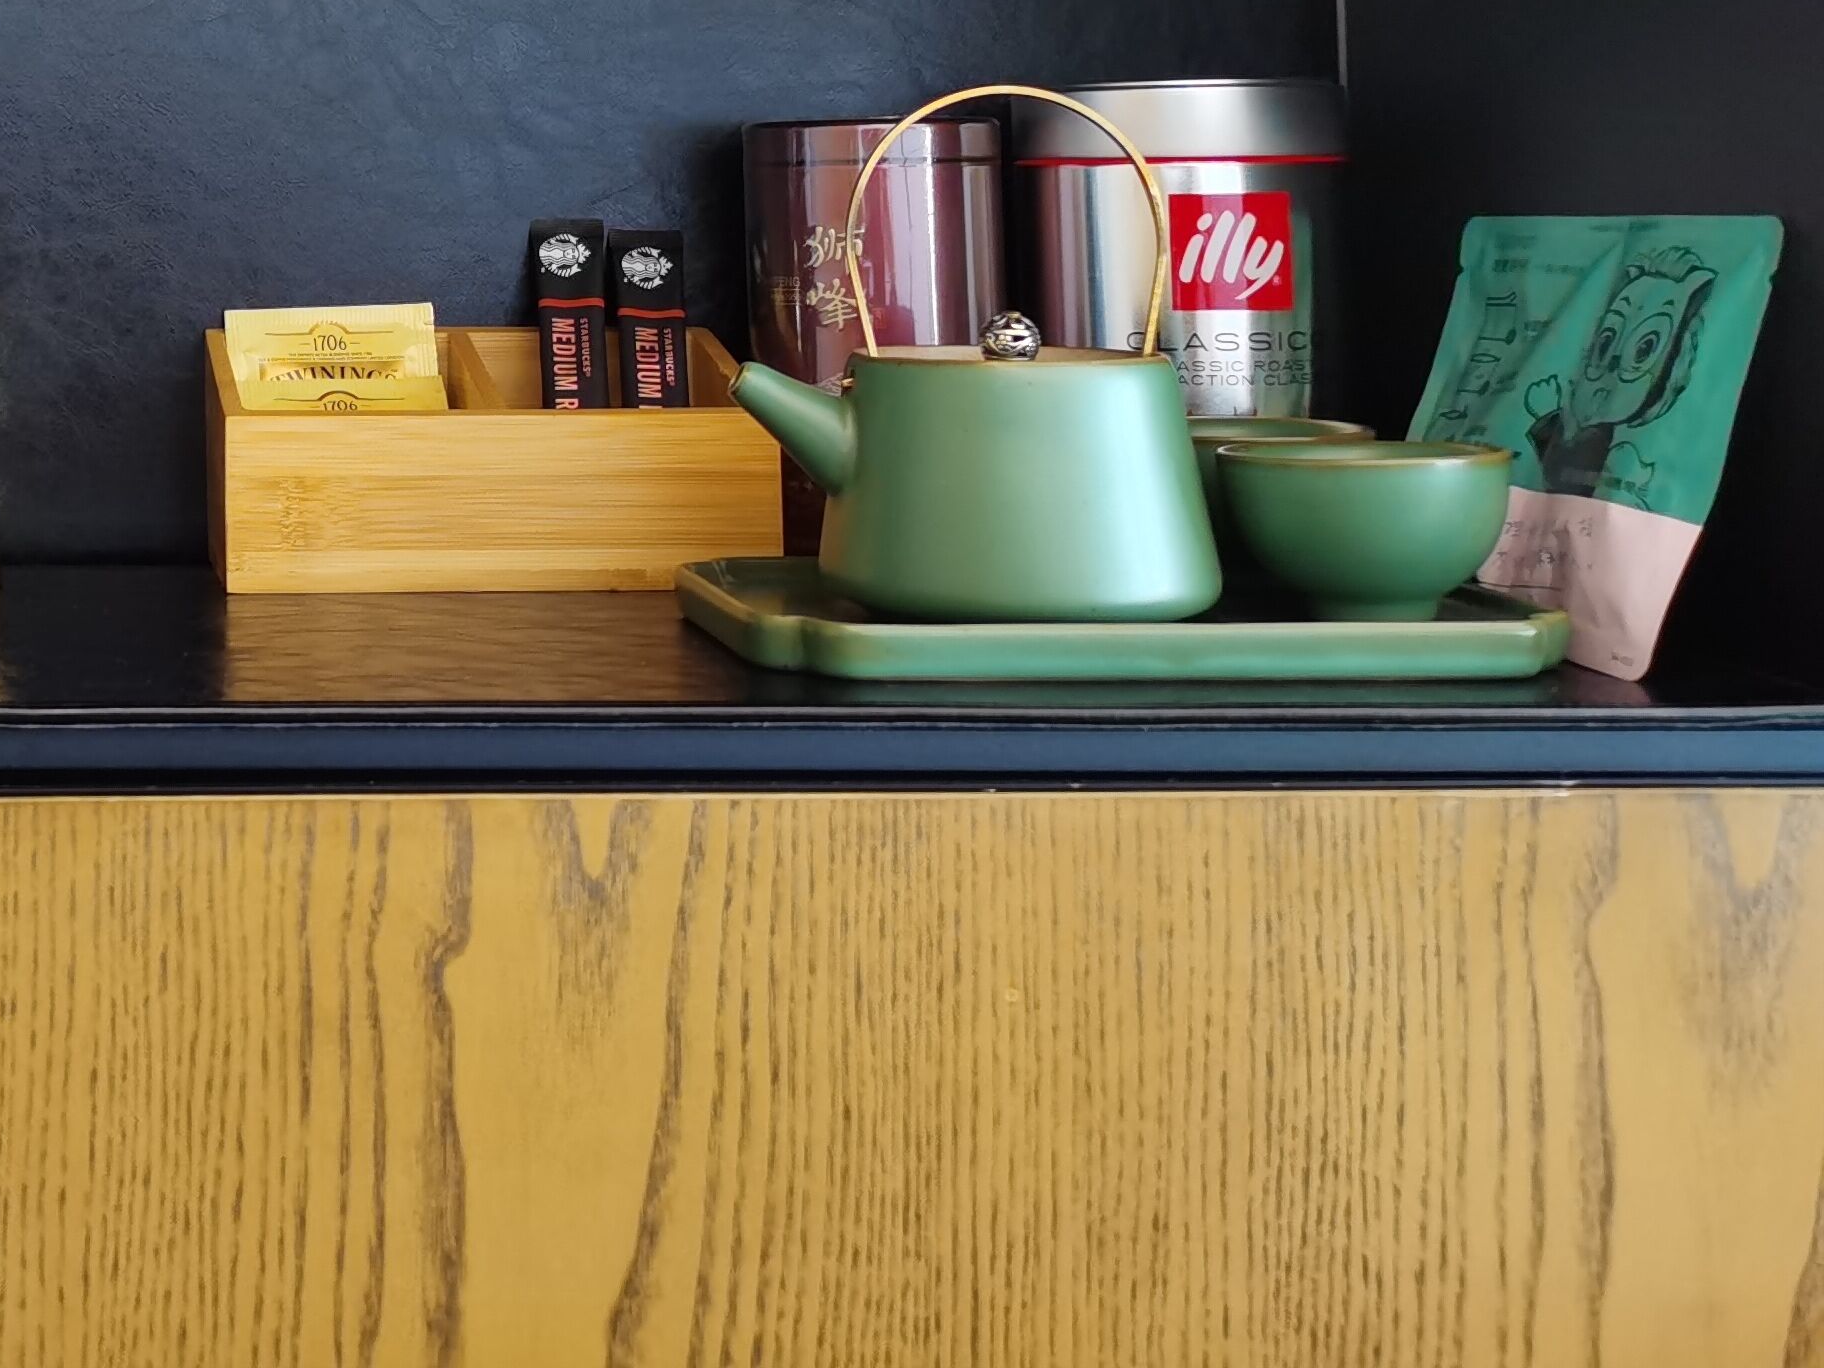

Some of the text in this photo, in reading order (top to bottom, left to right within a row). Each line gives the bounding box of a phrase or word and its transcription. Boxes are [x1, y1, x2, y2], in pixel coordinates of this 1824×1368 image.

[1178, 210, 1285, 301] illy
[314, 334, 347, 351] 1706
[551, 317, 578, 391] MEDIUM
[634, 327, 662, 398] MEDIUM
[323, 399, 358, 411] 1706
